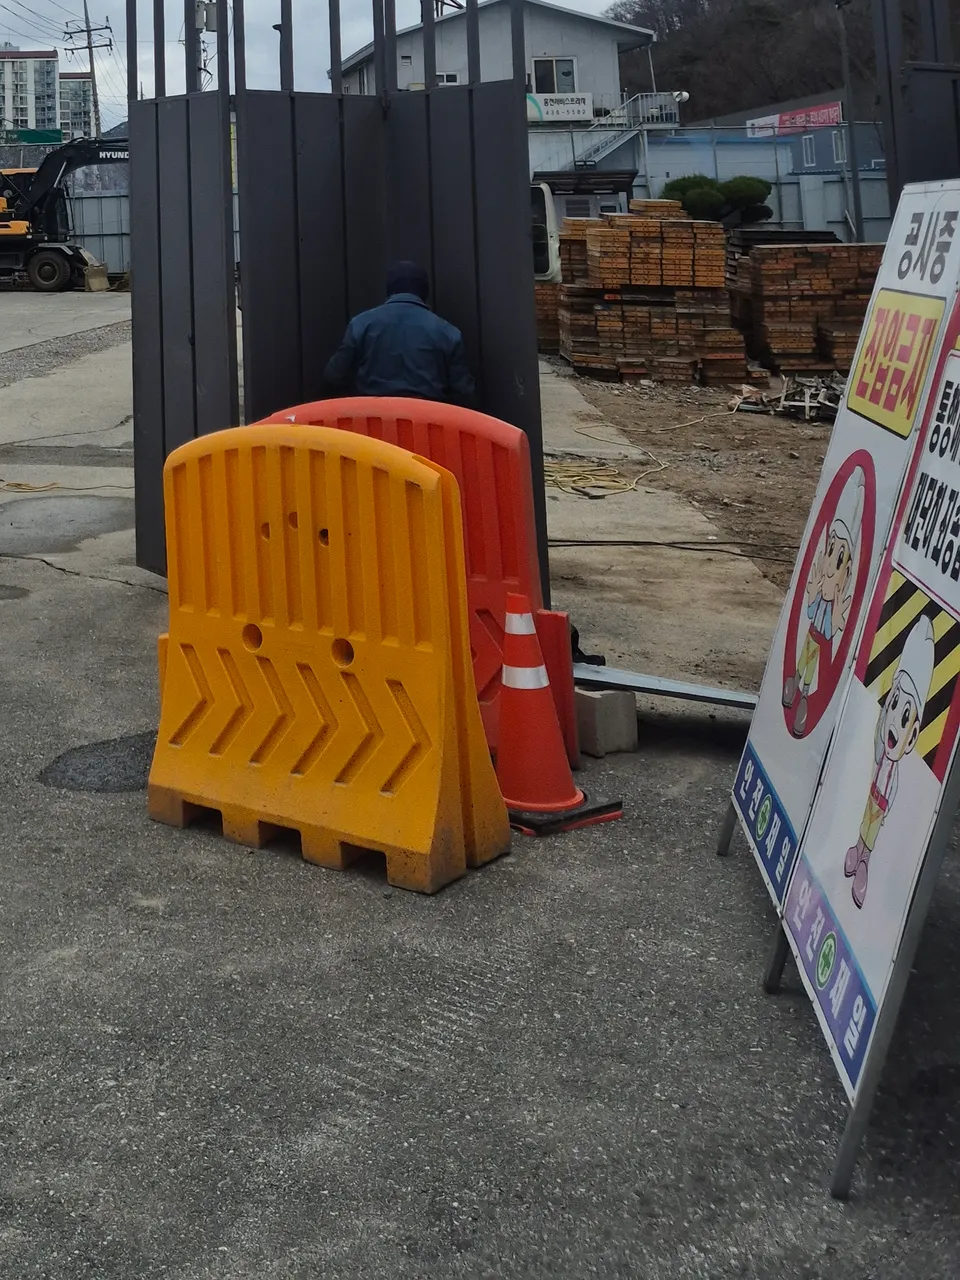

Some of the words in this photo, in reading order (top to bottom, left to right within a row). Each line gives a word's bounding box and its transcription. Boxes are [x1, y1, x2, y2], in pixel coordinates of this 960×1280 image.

[897, 210, 959, 285] 공사중
[855, 307, 938, 420] 진입금지
[903, 471, 949, 559] 대단히
